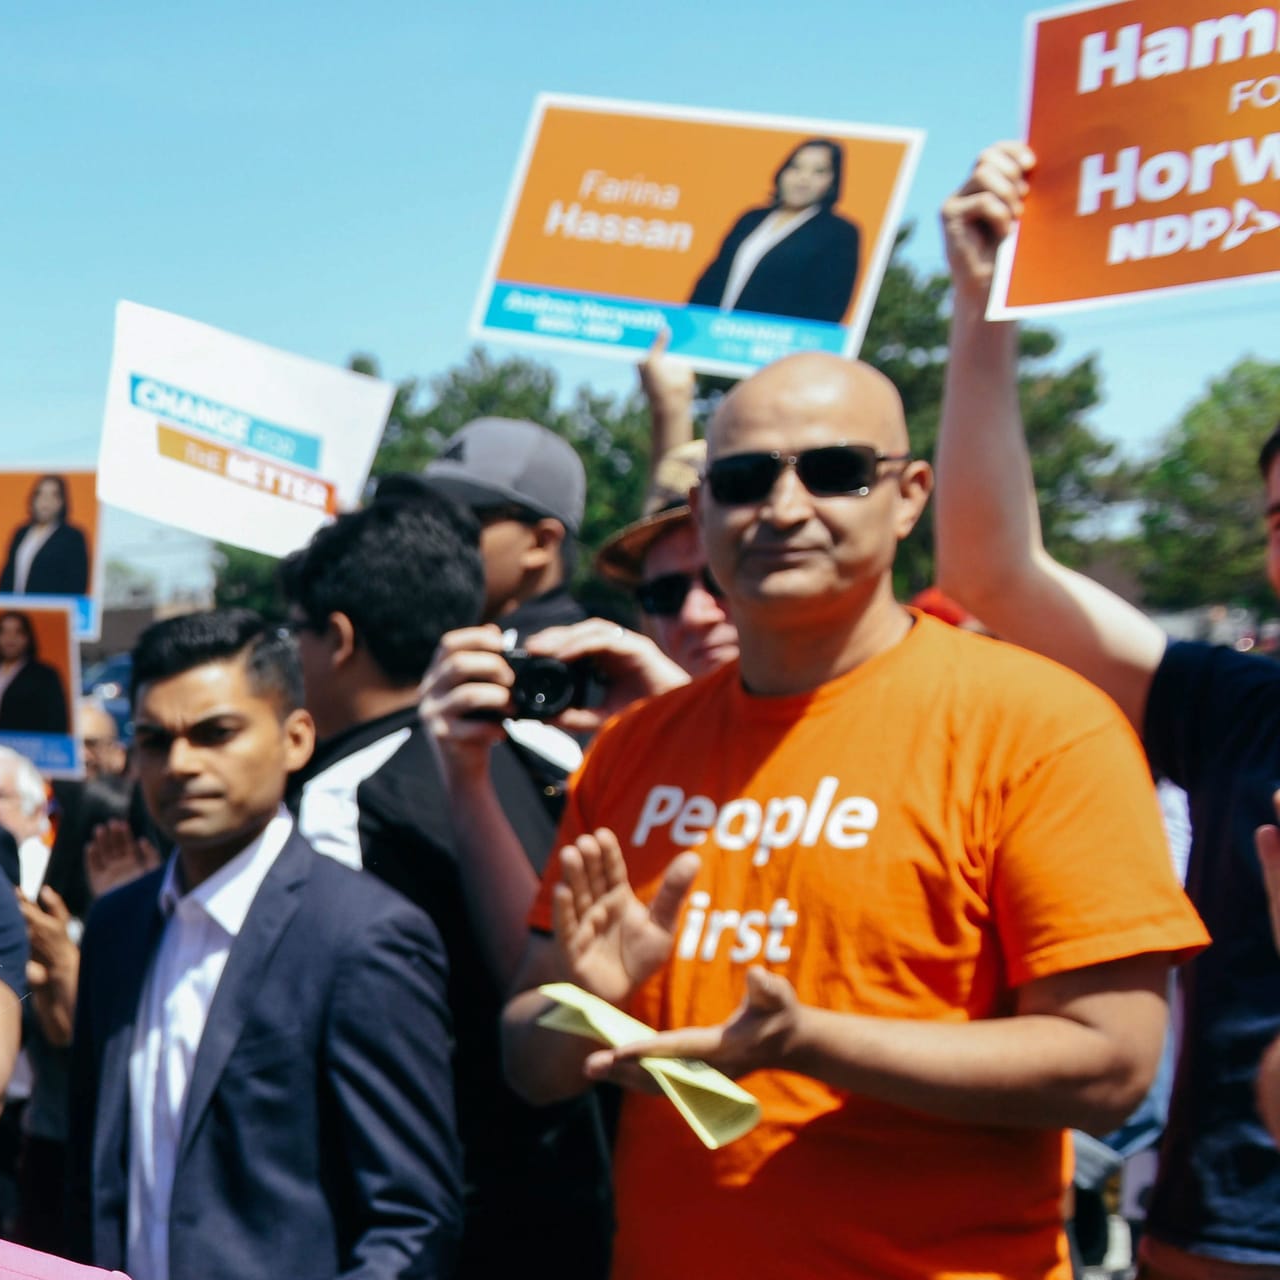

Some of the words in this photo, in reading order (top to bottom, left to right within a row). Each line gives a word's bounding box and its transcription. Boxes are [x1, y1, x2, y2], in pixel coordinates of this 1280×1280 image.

[1078, 8, 1280, 94] Ham
[578, 168, 681, 210] Farina
[544, 199, 694, 253] Hassan
[1107, 206, 1231, 265] NDP
[631, 776, 879, 867] People
[677, 891, 798, 963] irst
